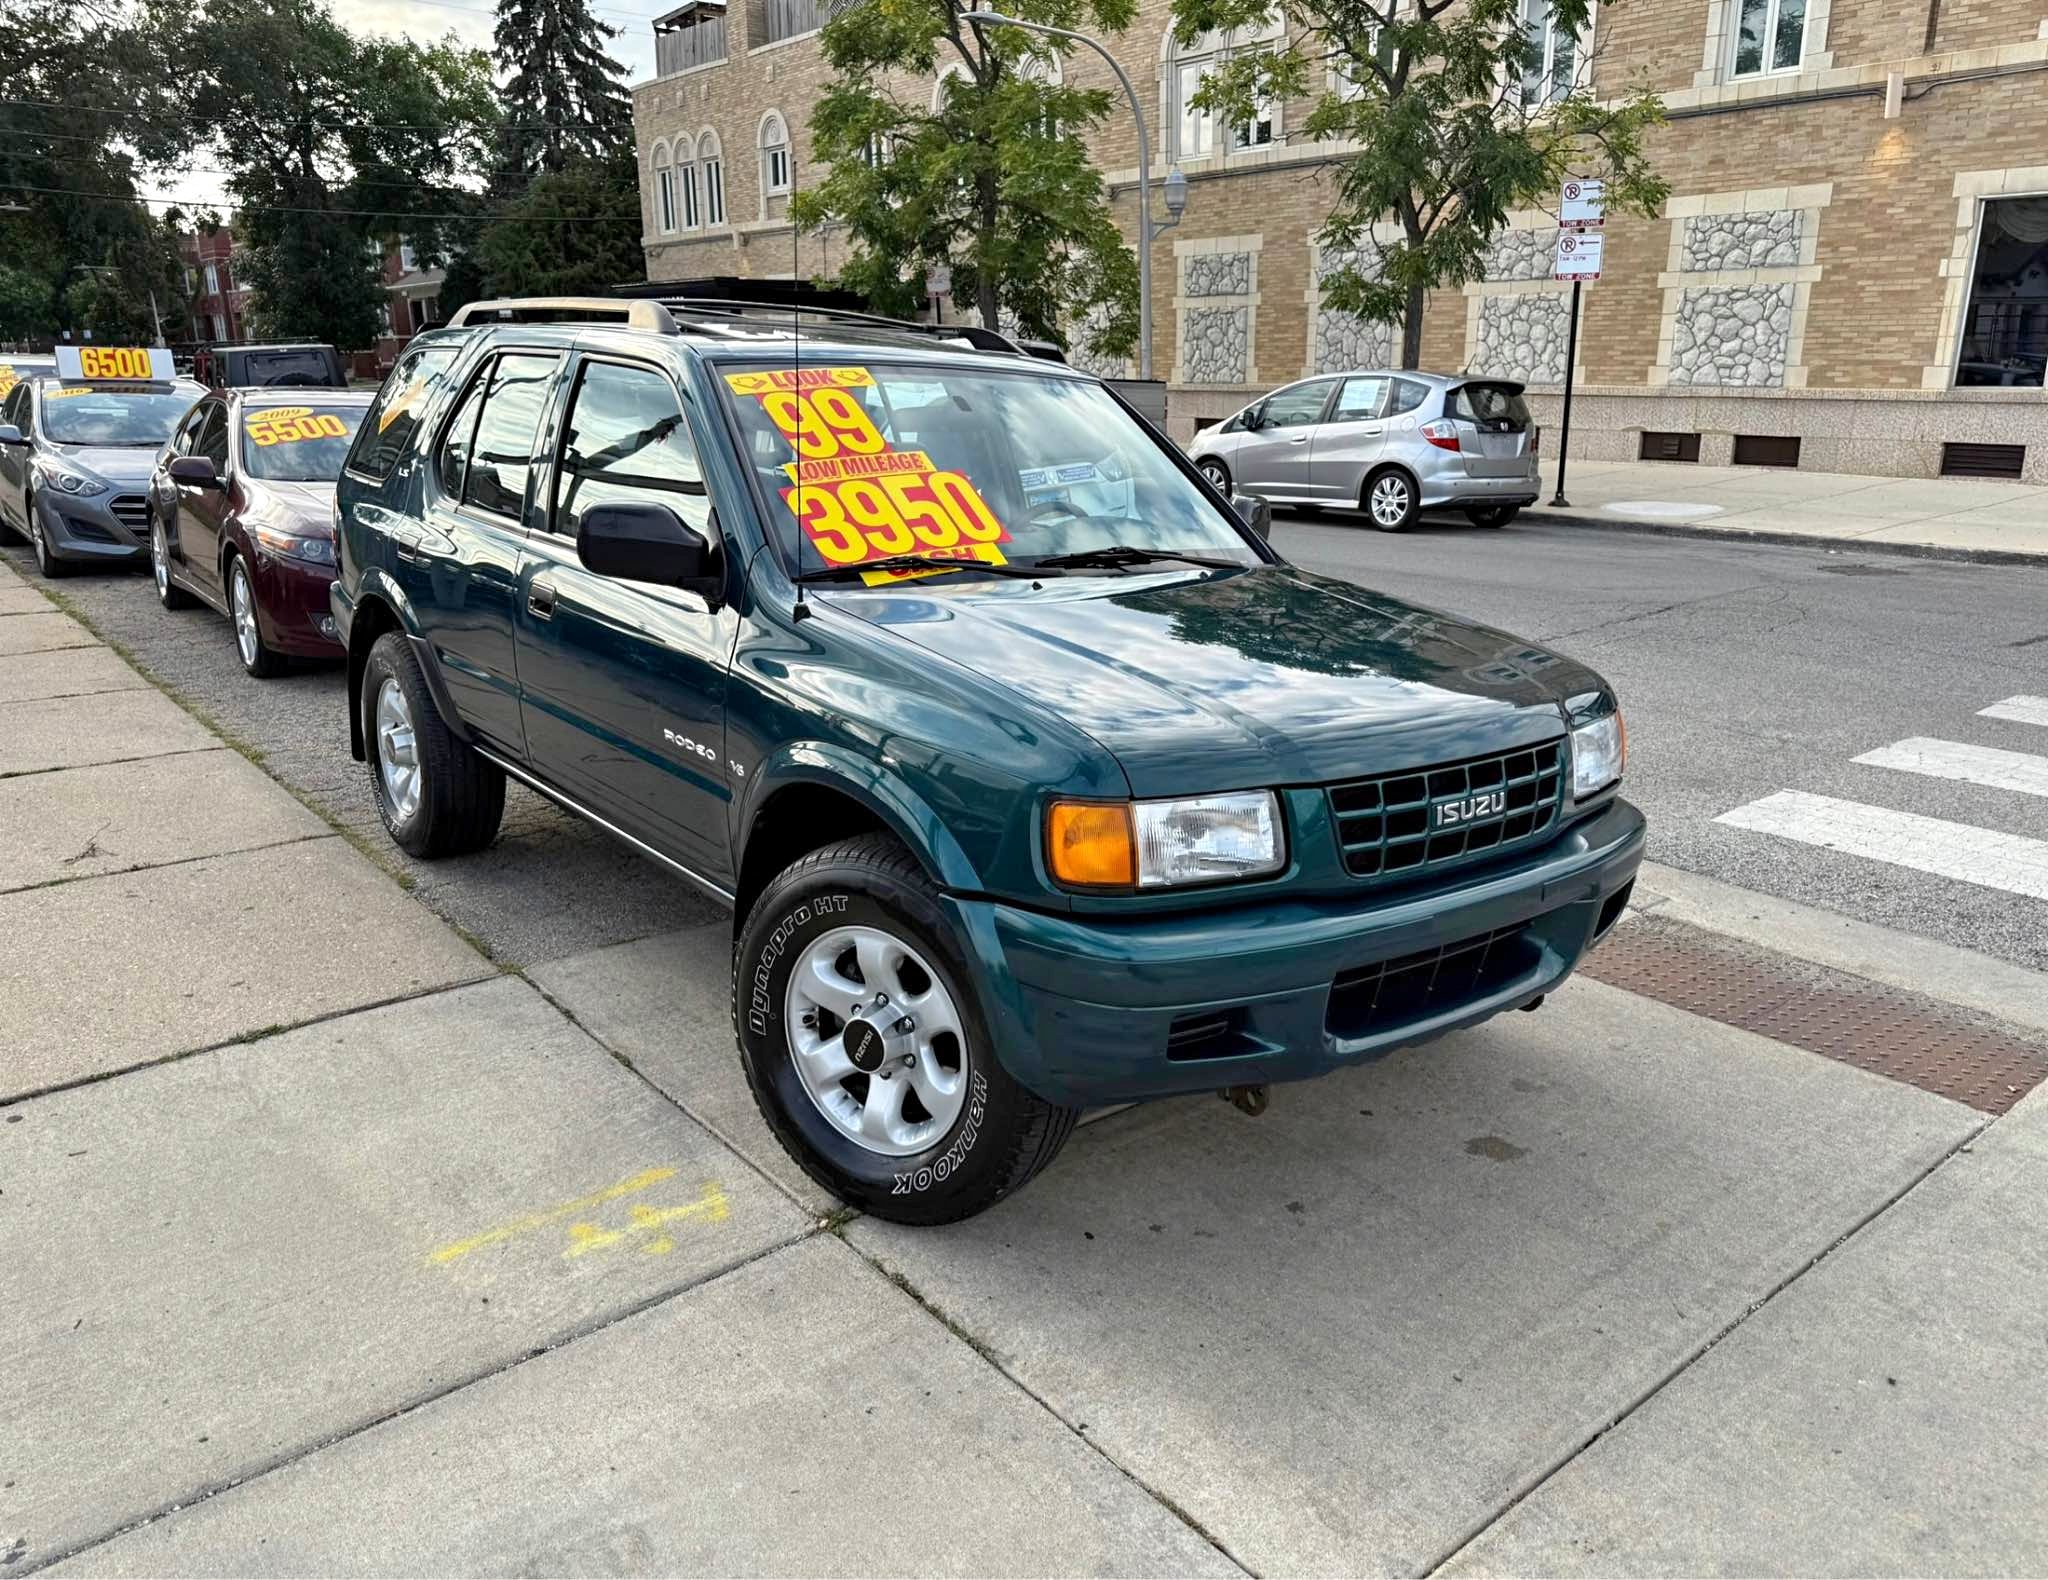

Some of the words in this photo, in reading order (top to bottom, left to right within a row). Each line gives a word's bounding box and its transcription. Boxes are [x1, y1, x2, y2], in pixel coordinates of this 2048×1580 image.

[1576, 272, 1595, 280] ZONE
[80, 348, 151, 378] 6500
[768, 370, 836, 388] LOOK
[258, 408, 301, 419] 2009
[762, 388, 885, 458] 99
[246, 415, 347, 446] 5500
[795, 460, 839, 480] LOW
[842, 453, 923, 475] MILEAGE
[788, 472, 1001, 563] 3950
[664, 728, 716, 761] RODEO
[730, 760, 744, 776] V6
[1437, 792, 1504, 826] ISUZU
[749, 906, 811, 1036] Dynapro
[815, 896, 848, 915] HT
[855, 1031, 873, 1062] ISUZU
